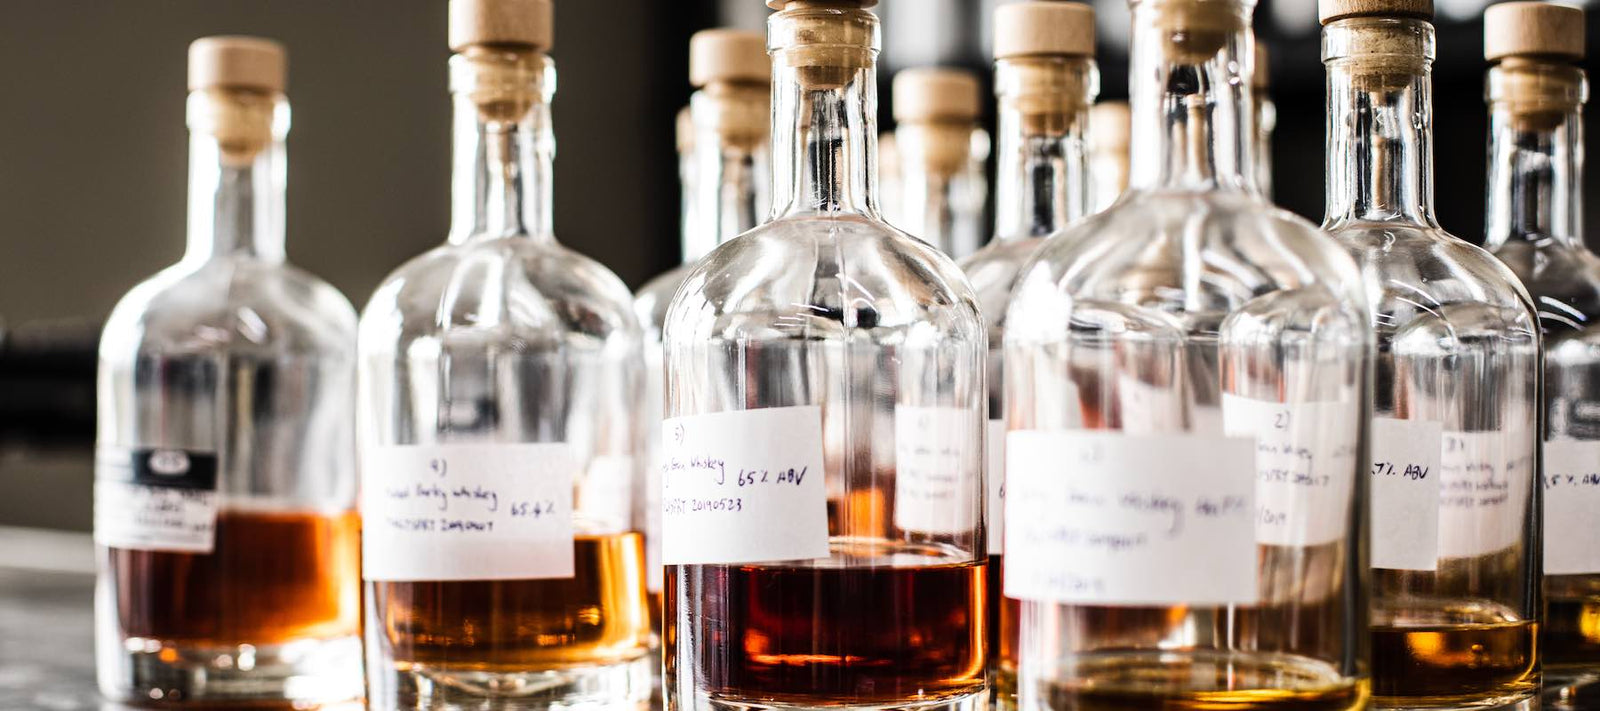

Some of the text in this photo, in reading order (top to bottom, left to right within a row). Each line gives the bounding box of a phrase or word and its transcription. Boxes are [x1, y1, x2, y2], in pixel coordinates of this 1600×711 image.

[776, 466, 808, 486] ABV
[1403, 464, 1429, 480] ABV
[692, 497, 742, 512] 20190523
